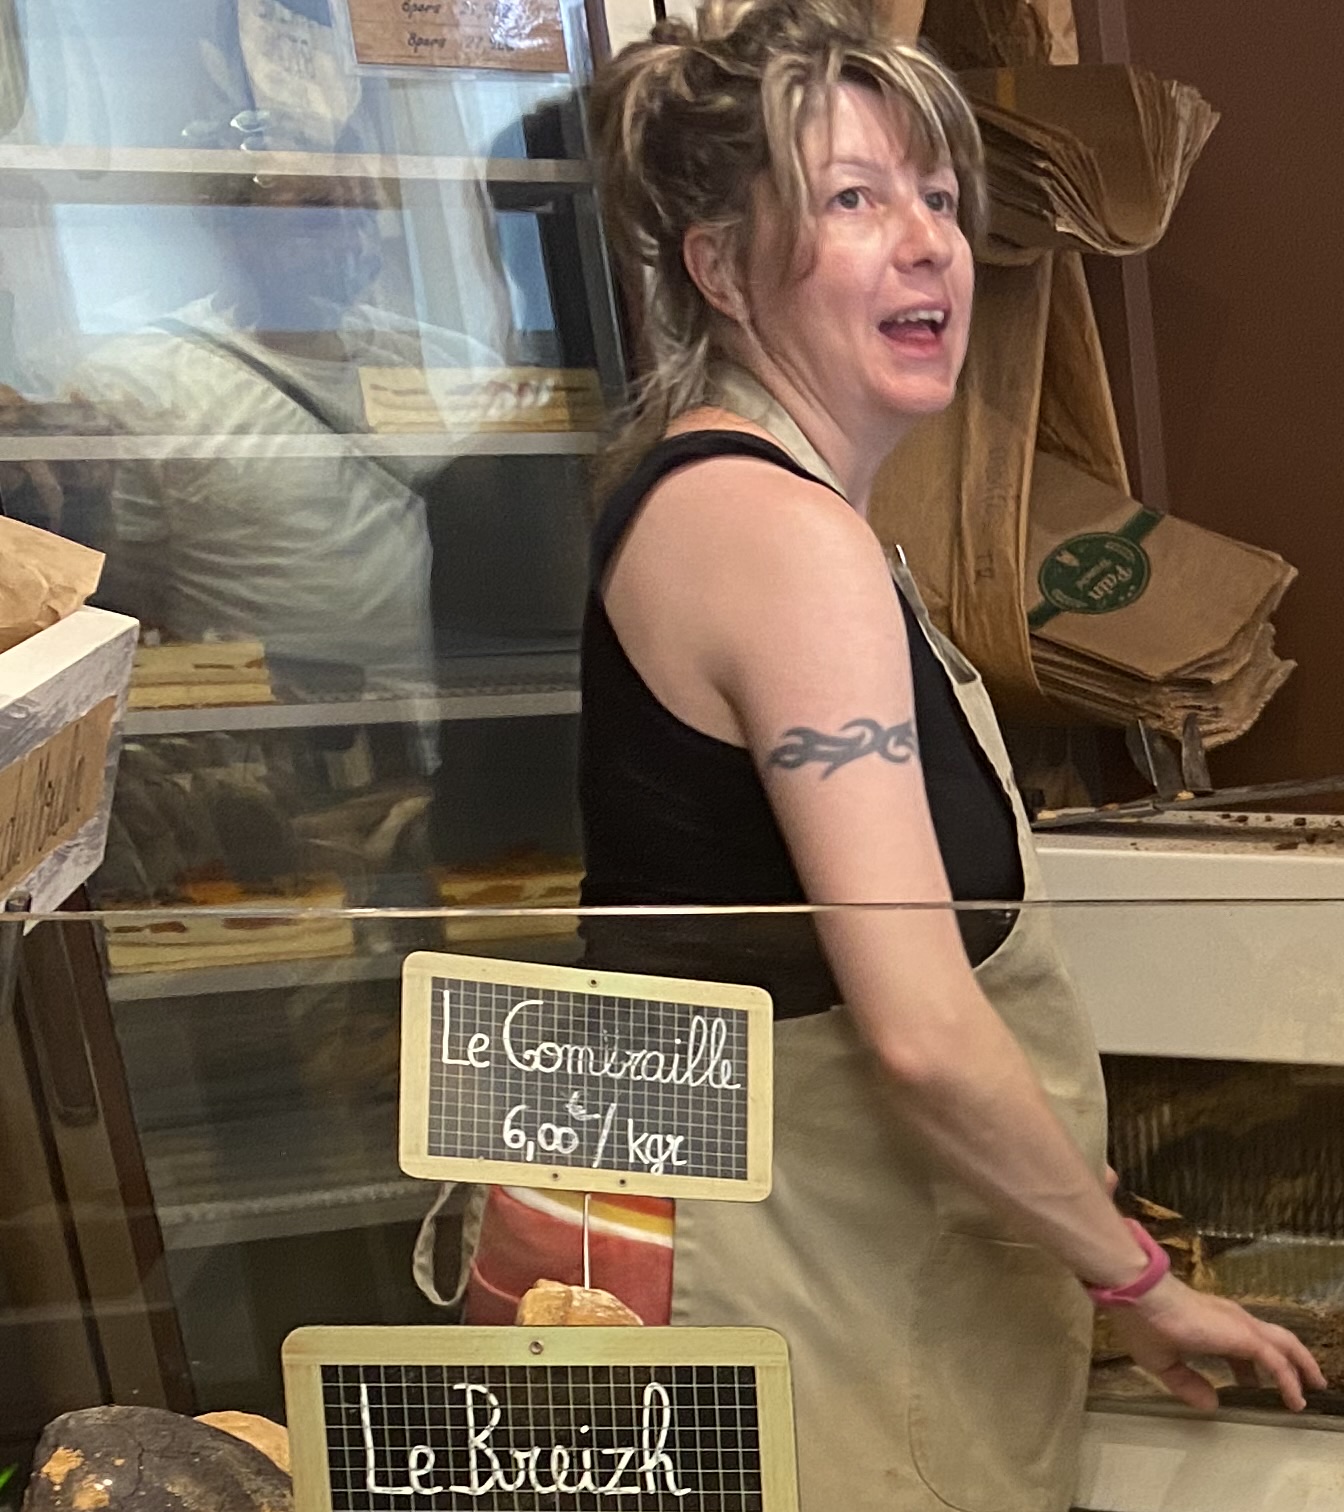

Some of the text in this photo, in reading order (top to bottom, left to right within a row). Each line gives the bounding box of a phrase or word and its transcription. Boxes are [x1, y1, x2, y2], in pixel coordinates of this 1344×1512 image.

[441, 989, 491, 1068] Le
[360, 1381, 692, 1498] Le Breizh
